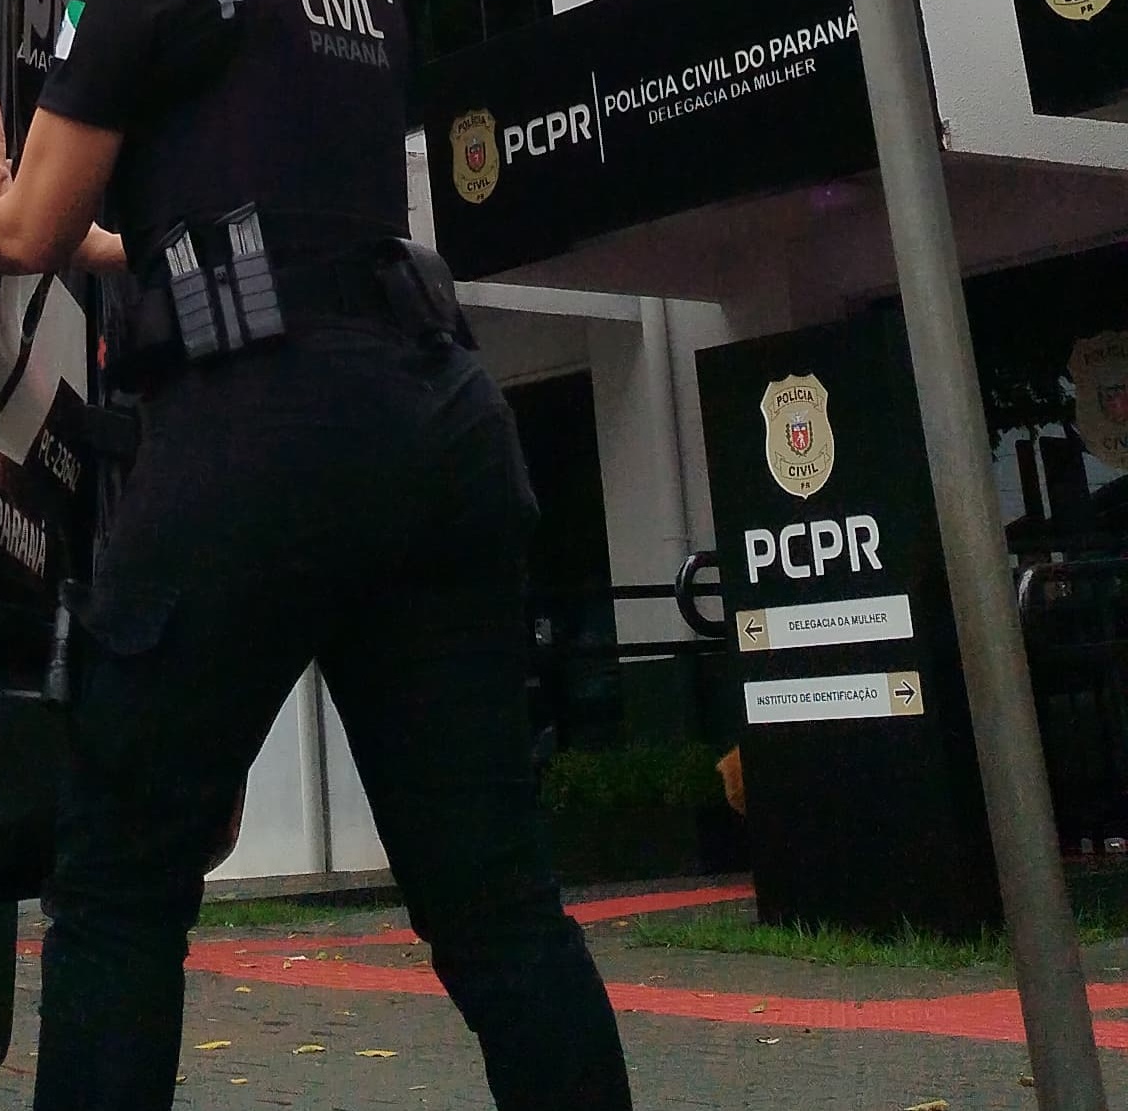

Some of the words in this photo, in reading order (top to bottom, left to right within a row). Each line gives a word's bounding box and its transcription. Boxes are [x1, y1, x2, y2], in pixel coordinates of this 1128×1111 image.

[1080, 3, 1094, 15] PR
[309, 30, 391, 70] PARANÁ
[604, 74, 679, 118] POLÍCIA
[681, 57, 732, 92] CIVIL
[734, 44, 765, 74] DO
[769, 6, 858, 63] PARANÁ
[648, 87, 728, 126] DELEGACIA
[731, 79, 752, 99] DA
[753, 58, 816, 92] MULHER
[503, 103, 594, 165] PCPR
[467, 178, 490, 192] CIVIL
[776, 388, 815, 407] POLÍCIA
[788, 463, 819, 477] CIVIL
[744, 514, 883, 584] PCPR
[788, 617, 837, 631] DELEGACIA
[838, 616, 851, 627] DA
[851, 613, 888, 626] MULHER
[756, 693, 798, 706] INSTITUTO
[799, 692, 811, 703] DE
[812, 687, 878, 703] IDENTIFICAÇÃO
